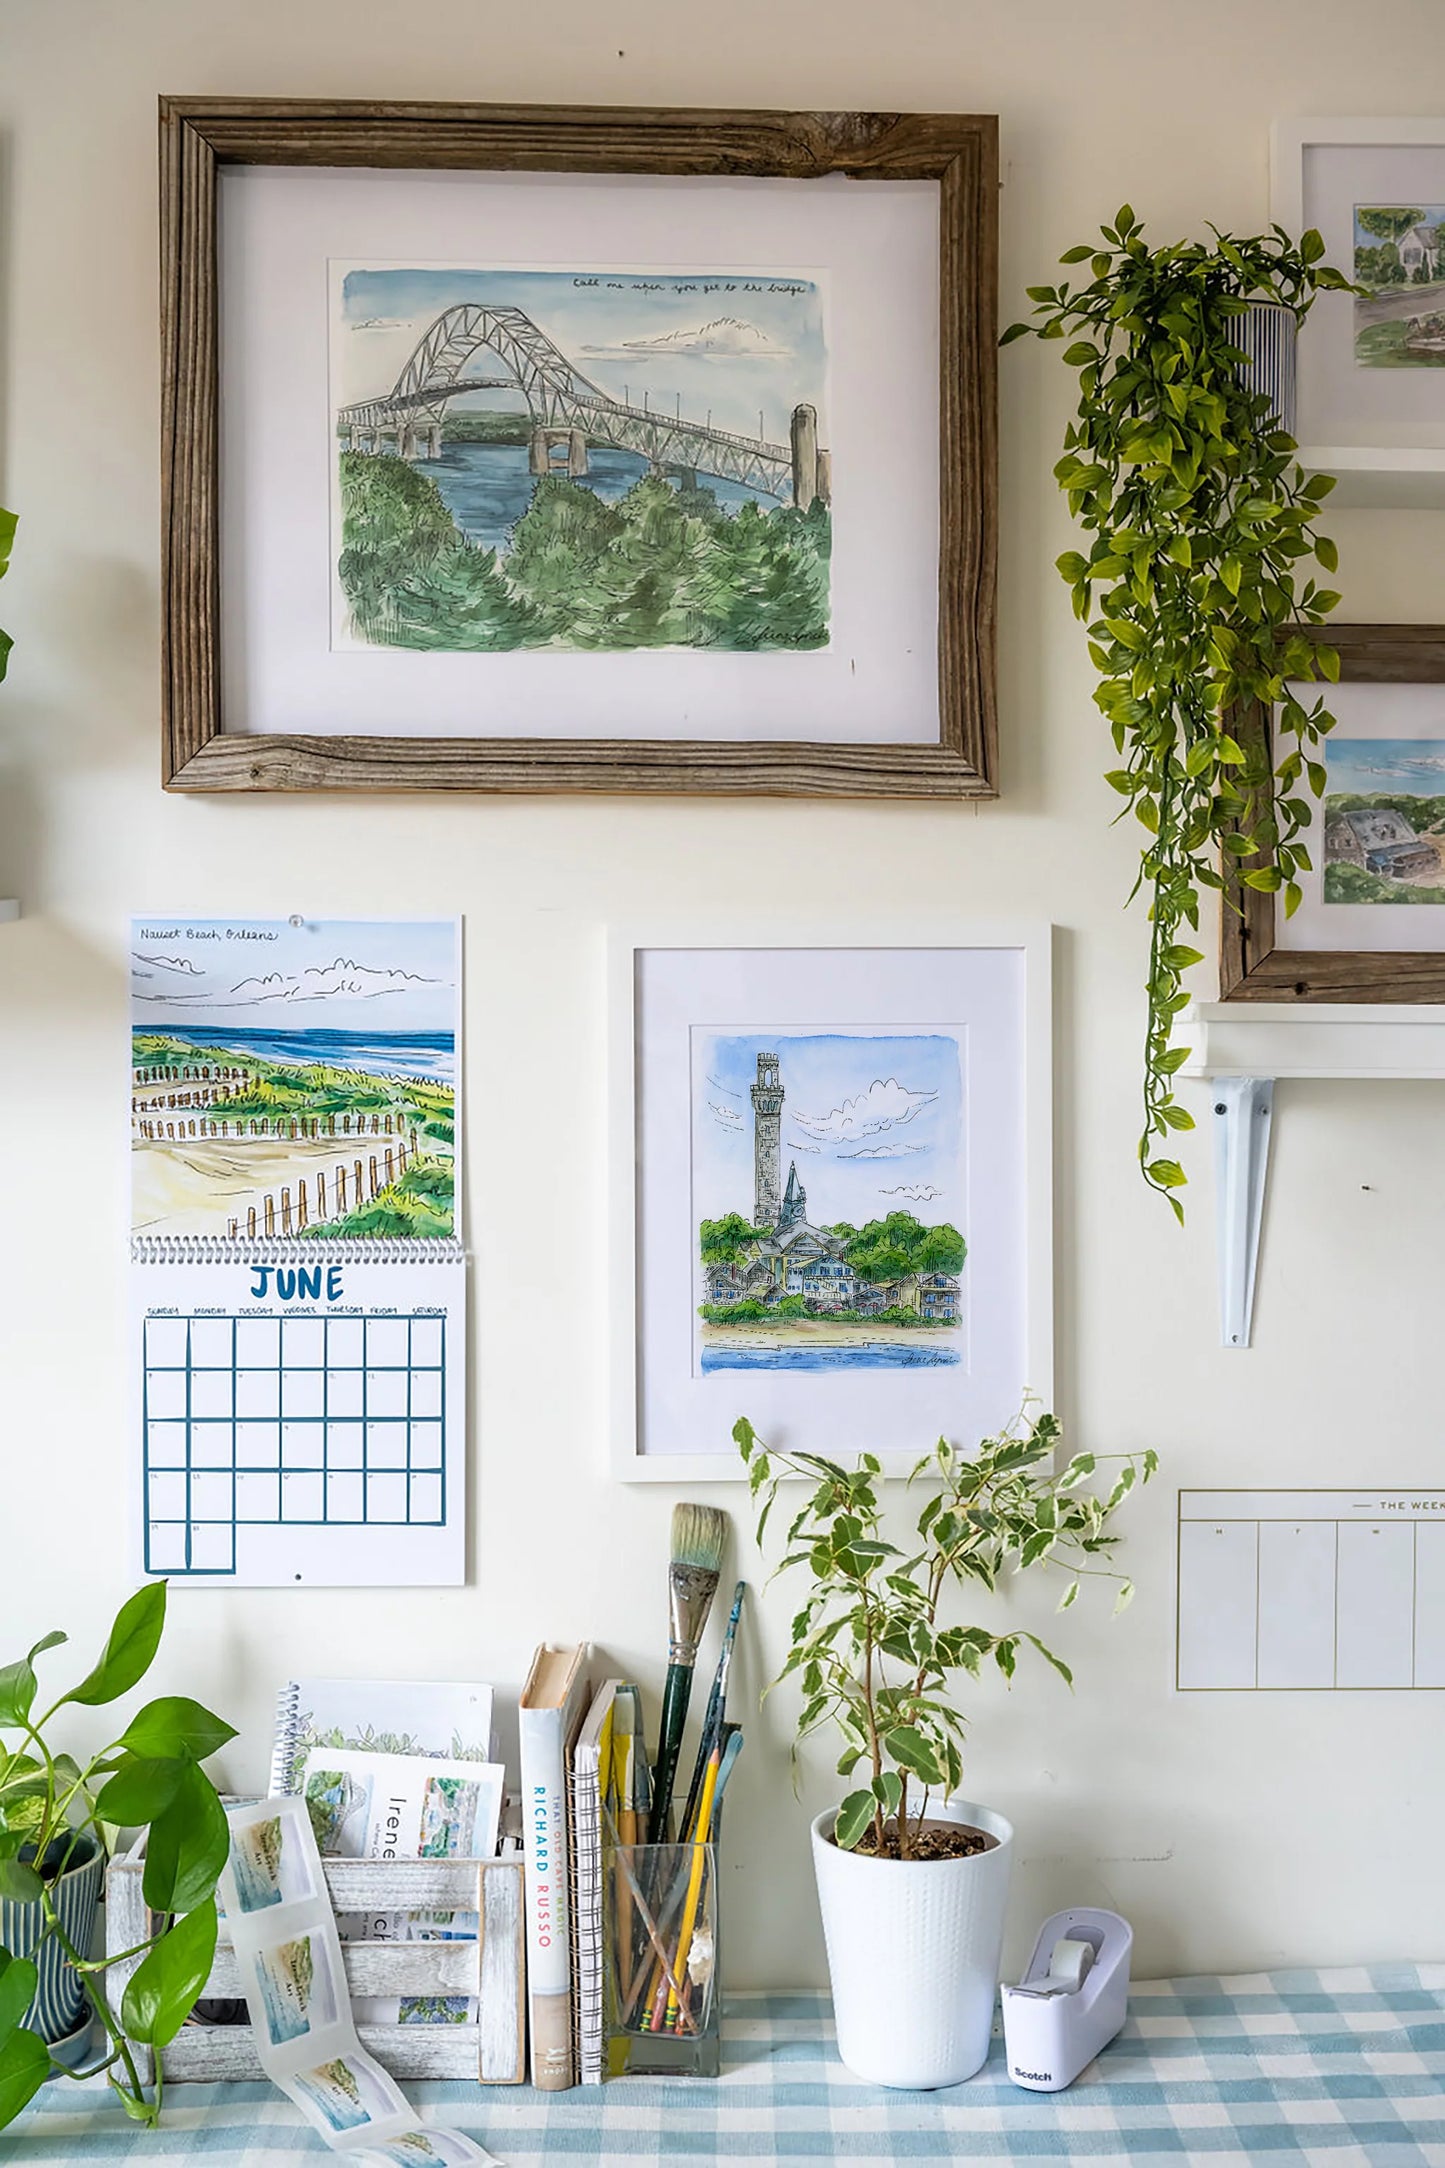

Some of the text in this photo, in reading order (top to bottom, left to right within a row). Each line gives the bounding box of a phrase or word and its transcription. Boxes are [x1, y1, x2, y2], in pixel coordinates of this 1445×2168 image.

[250, 1265, 344, 1301] JUNE
[1380, 1501, 1406, 1510] THE
[382, 1797, 407, 1858] Irene
[534, 1787, 552, 1947] RICHARD RUSSO
[1014, 2067, 1052, 2082] Scotch
